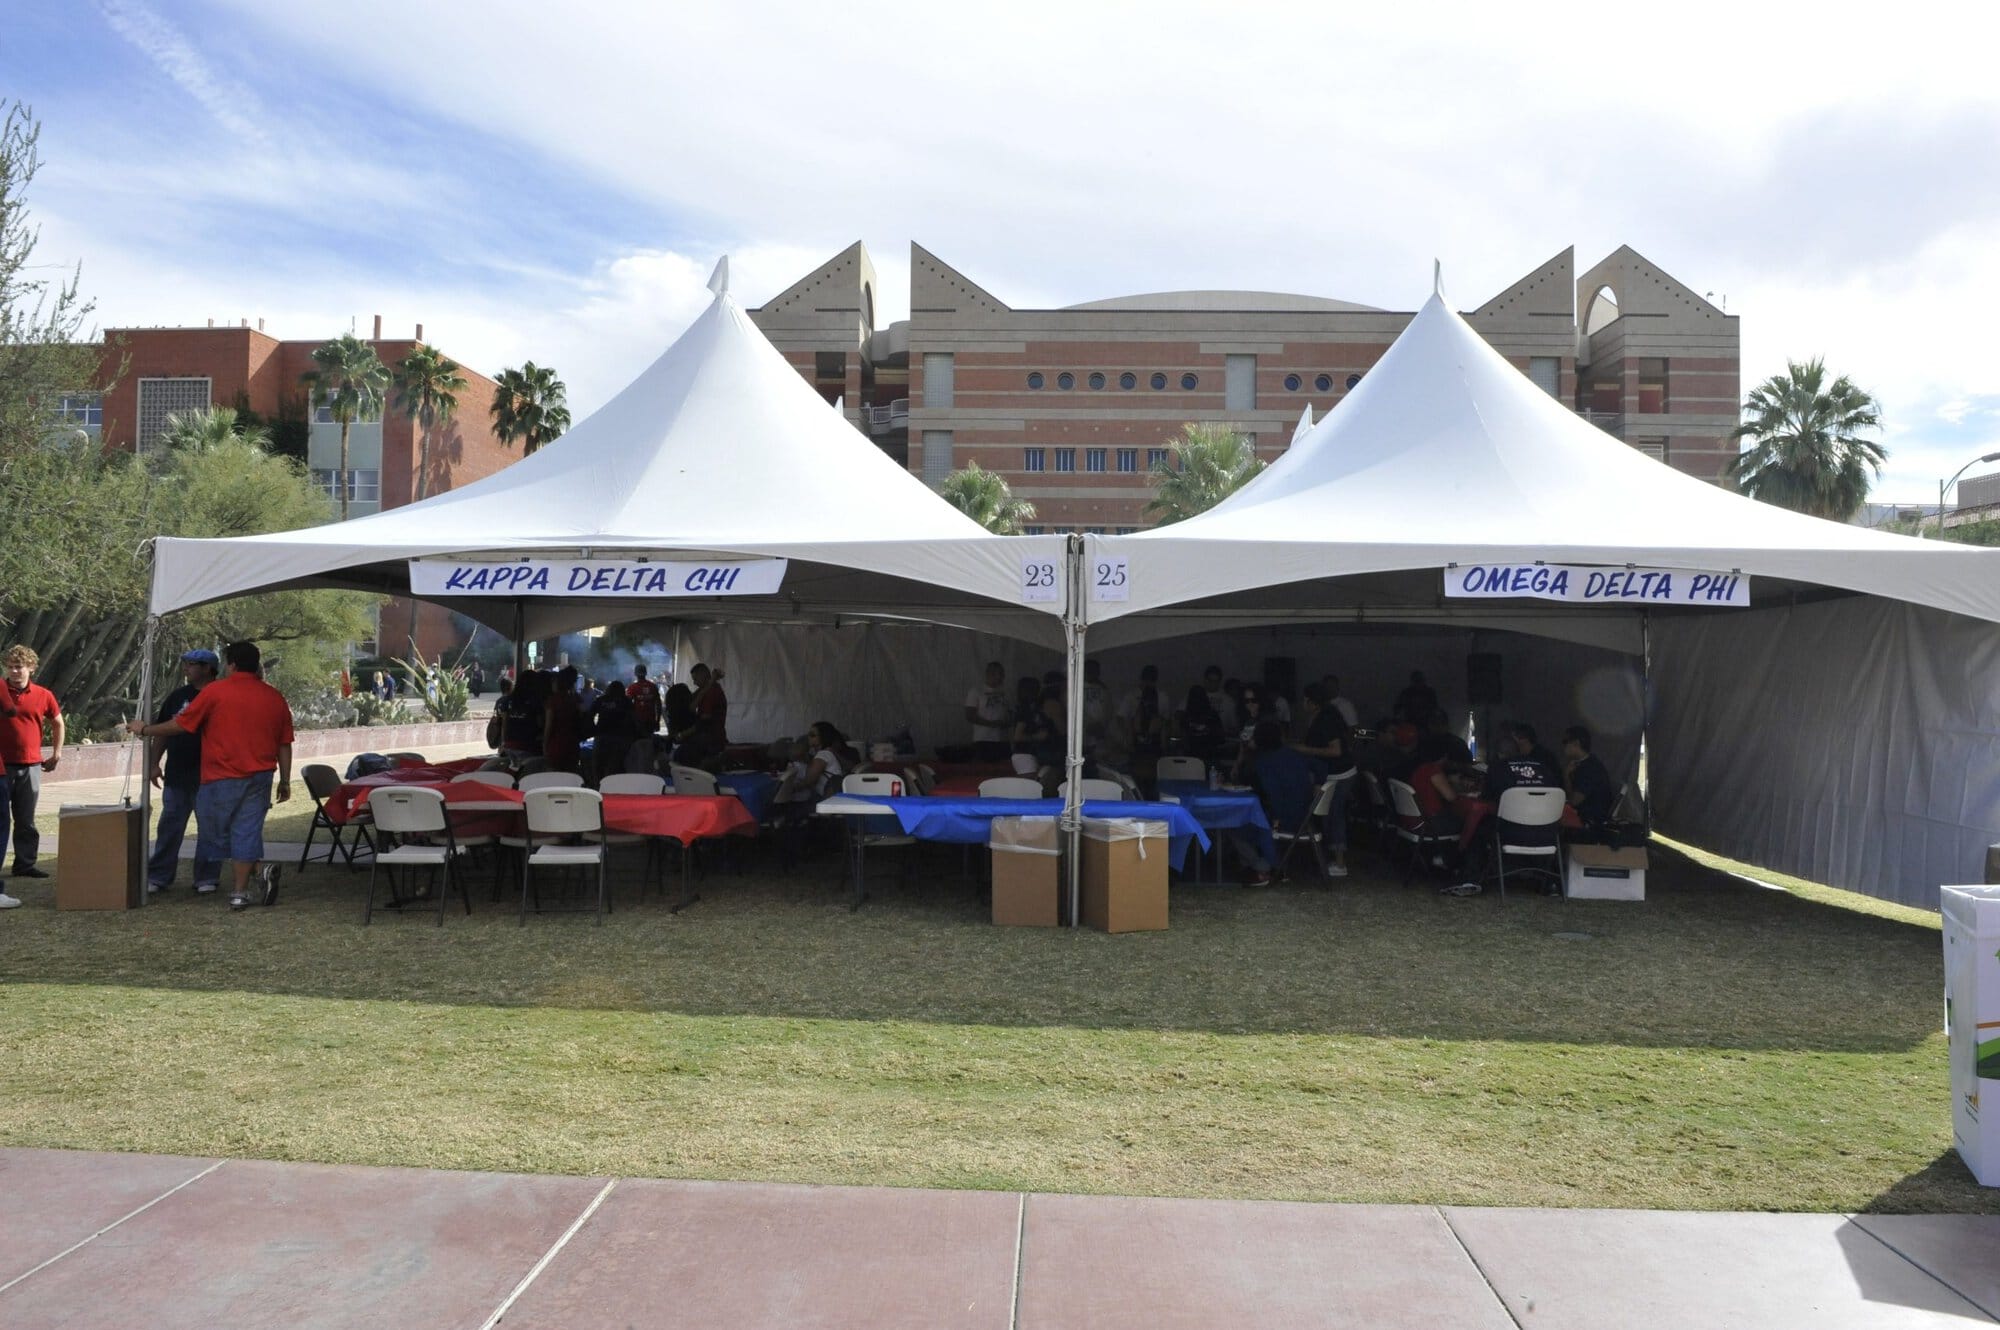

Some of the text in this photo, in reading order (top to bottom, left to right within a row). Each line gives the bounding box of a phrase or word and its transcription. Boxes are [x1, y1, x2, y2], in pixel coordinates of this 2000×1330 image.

[446, 566, 740, 592] KAPPA DELTA CHI
[1025, 564, 1055, 587] 23
[1097, 563, 1126, 586] 25
[1462, 566, 1739, 601] OMEGA DELTA PHI
